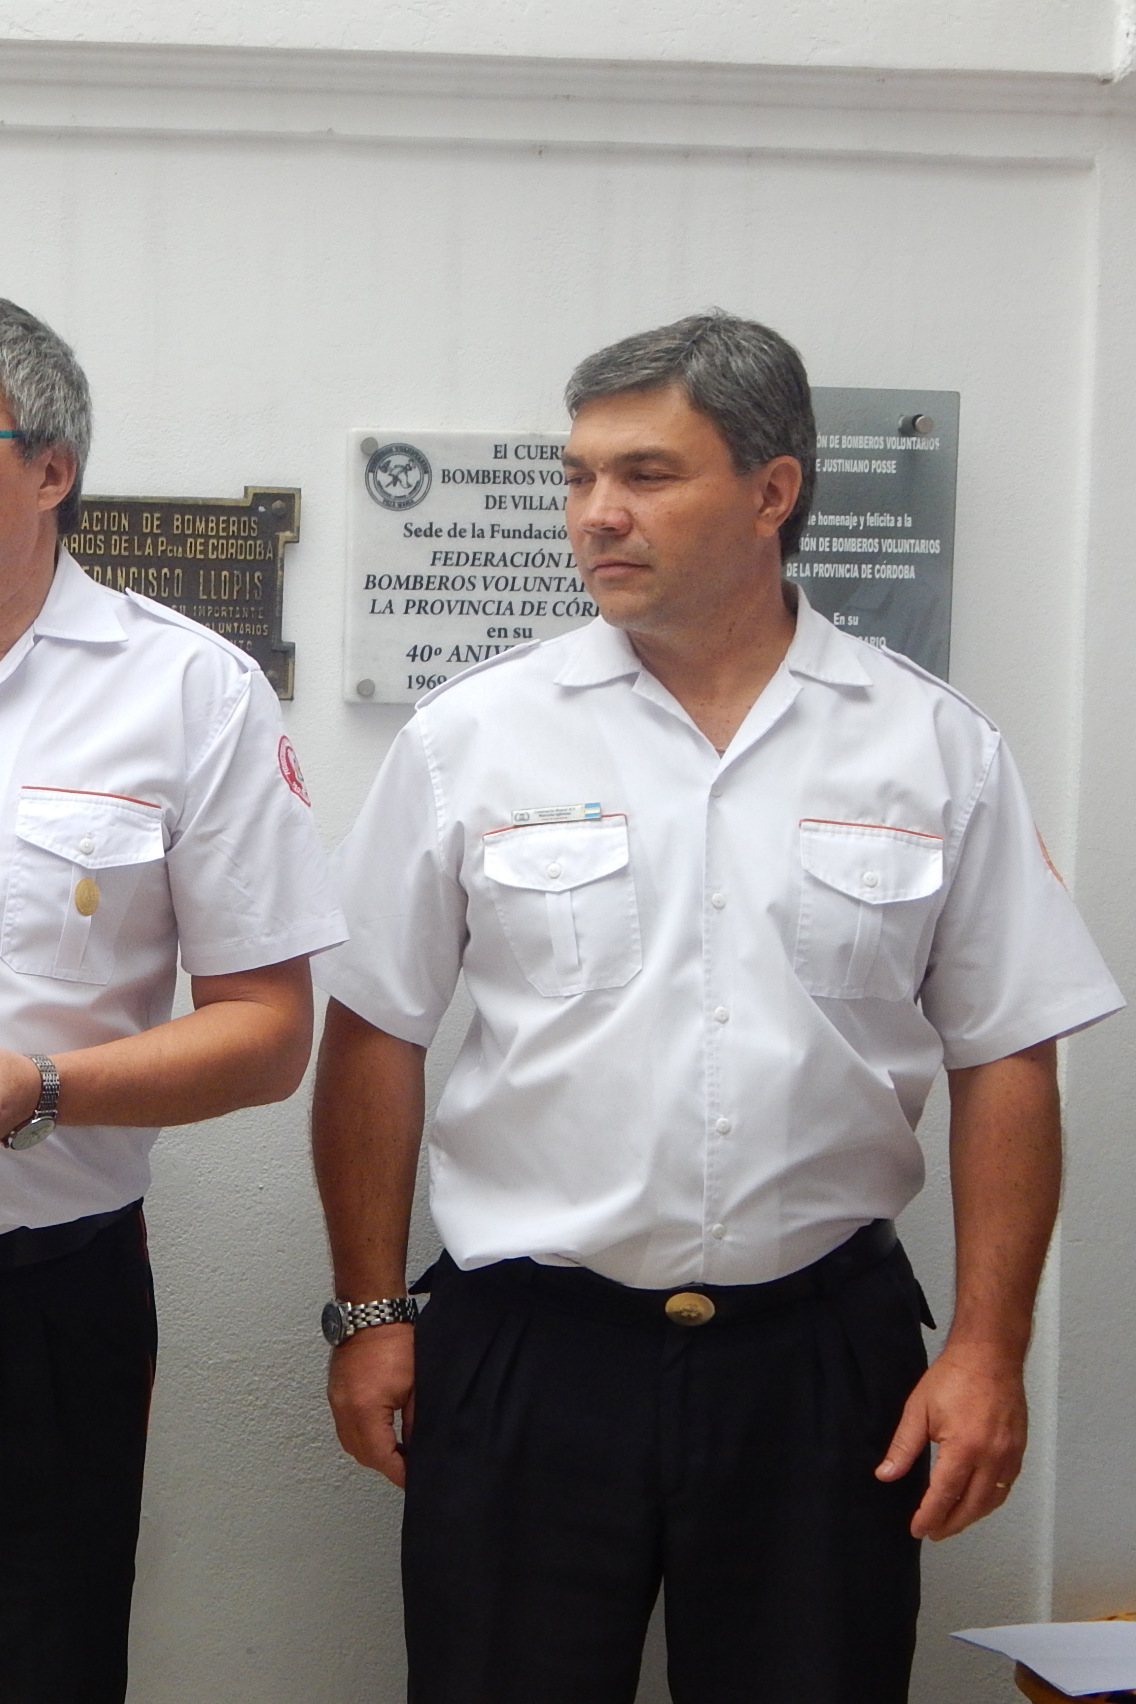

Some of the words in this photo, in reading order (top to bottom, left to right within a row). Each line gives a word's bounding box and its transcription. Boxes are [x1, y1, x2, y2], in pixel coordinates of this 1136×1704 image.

[830, 435, 839, 448] DE
[842, 435, 884, 449] BOMBEROS
[886, 436, 940, 450] VOLUNTARIOS
[493, 444, 508, 460] El
[823, 459, 869, 473] JUSTINIANO
[871, 460, 897, 473] POSSE
[441, 469, 535, 486] BOMBEROS
[484, 495, 508, 510] DE
[510, 495, 560, 511] VILLA
[143, 513, 161, 533] DE
[173, 514, 258, 537] BOMBEROS
[818, 511, 857, 530] homenaje
[859, 515, 864, 530] y
[866, 512, 895, 527] felicita
[897, 516, 902, 527] a
[904, 513, 912, 527] la
[403, 522, 443, 538] Sede
[447, 523, 467, 538] de
[471, 523, 485, 539] la
[489, 523, 568, 540] Fundació
[111, 535, 129, 556] DE
[135, 536, 153, 556] LA
[187, 538, 205, 558] DE
[208, 539, 274, 560] CORDOBA
[819, 537, 830, 552] DE
[832, 537, 879, 553] BOMBEROS
[881, 538, 941, 554] VOLUNTARIOS
[430, 548, 562, 568] FEDERACIÓN
[786, 562, 798, 577] DE
[800, 563, 811, 577] LA
[813, 563, 860, 578] PROVINCIA
[861, 563, 873, 579] DE
[874, 560, 915, 579] CÓRDOBA
[199, 569, 263, 600] LLOPIS
[364, 574, 476, 592] BOMBEROS
[193, 605, 264, 619] IMPORTANTE
[369, 599, 395, 614] LA
[403, 599, 515, 616] PROVINCIA
[519, 601, 548, 616] DE
[833, 612, 846, 625] En
[847, 615, 859, 625] su
[487, 627, 508, 638] en
[513, 627, 533, 638] su
